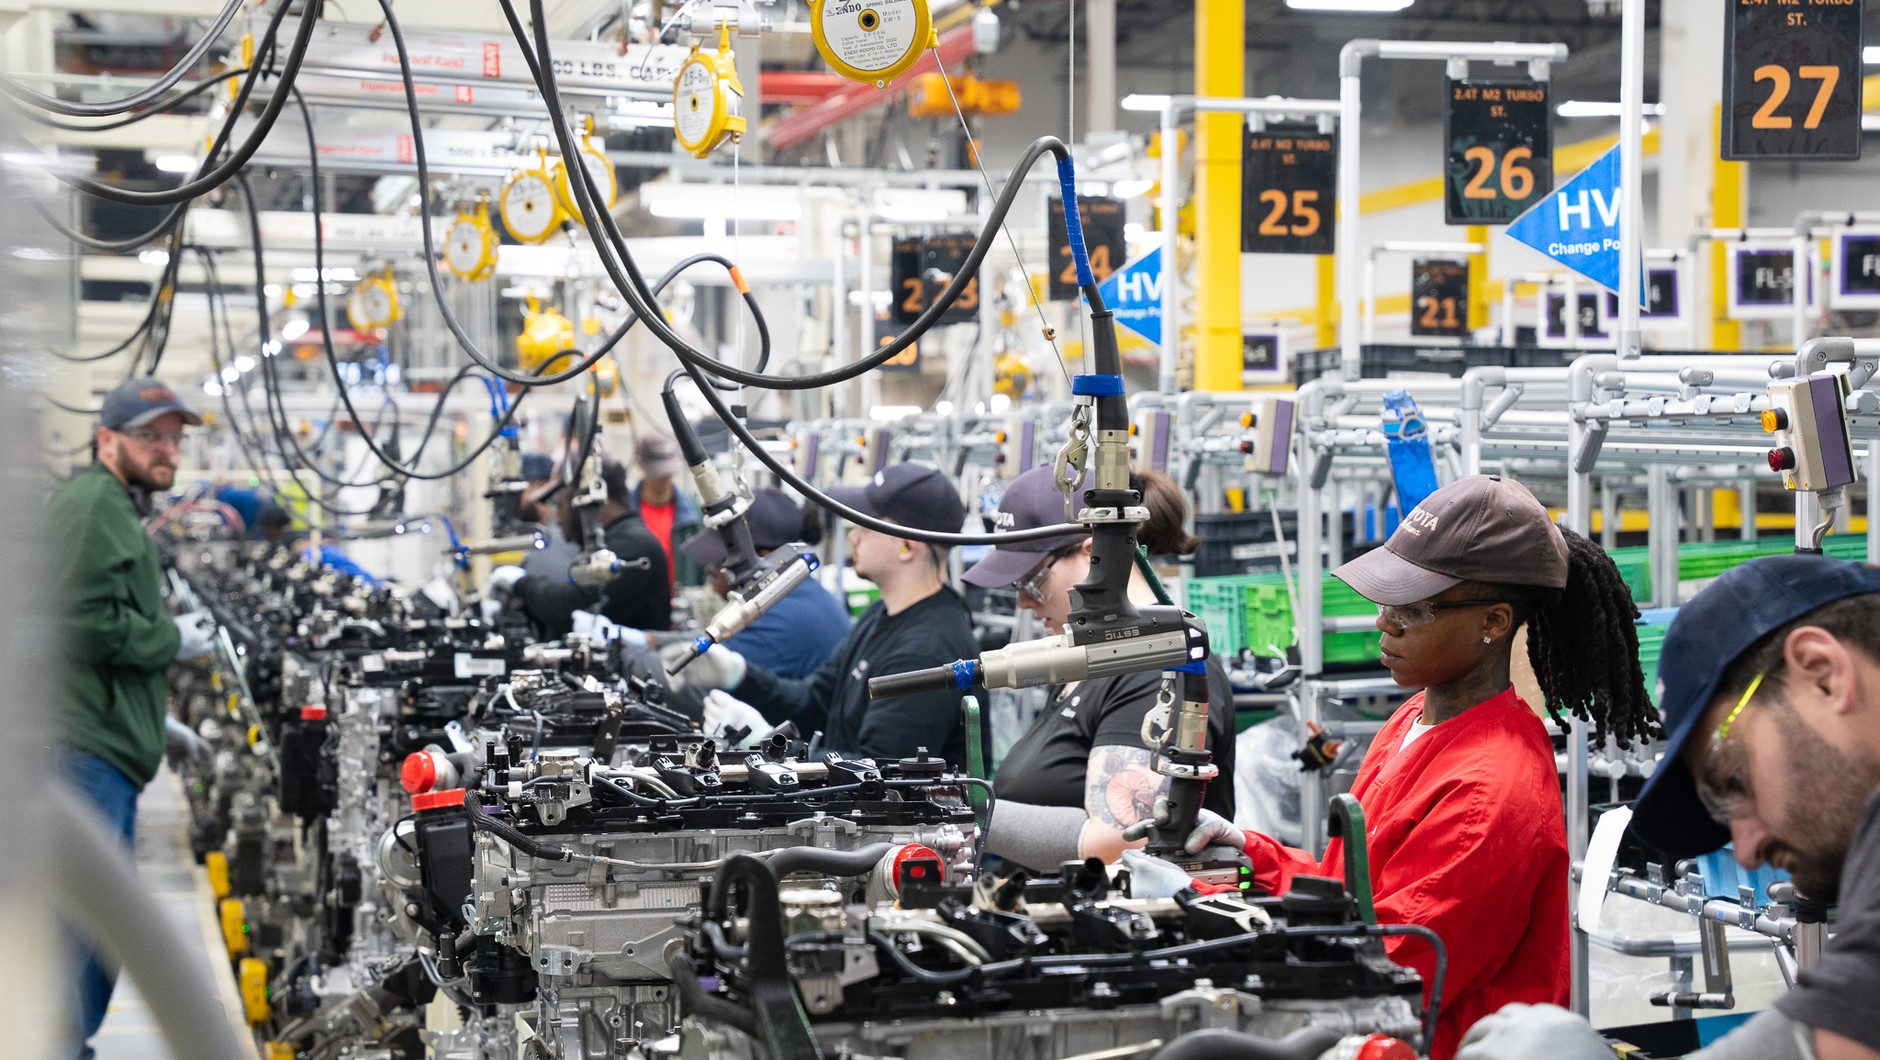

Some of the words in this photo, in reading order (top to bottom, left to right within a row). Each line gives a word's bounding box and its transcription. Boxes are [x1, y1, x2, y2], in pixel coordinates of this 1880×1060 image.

[1787, 12, 1807, 26] ST.
[1505, 89, 1544, 102] TURBO
[1752, 64, 1840, 129] 27
[1463, 146, 1535, 200] 26
[1258, 189, 1321, 237] 25
[1557, 187, 1621, 231] HV
[1549, 239, 1600, 256] Change
[1603, 237, 1621, 251] Po
[1059, 244, 1114, 284] 24
[902, 277, 924, 313] 2
[1117, 272, 1163, 301] HV
[1420, 296, 1460, 328] 21
[1105, 628, 1140, 641] ESTIC
